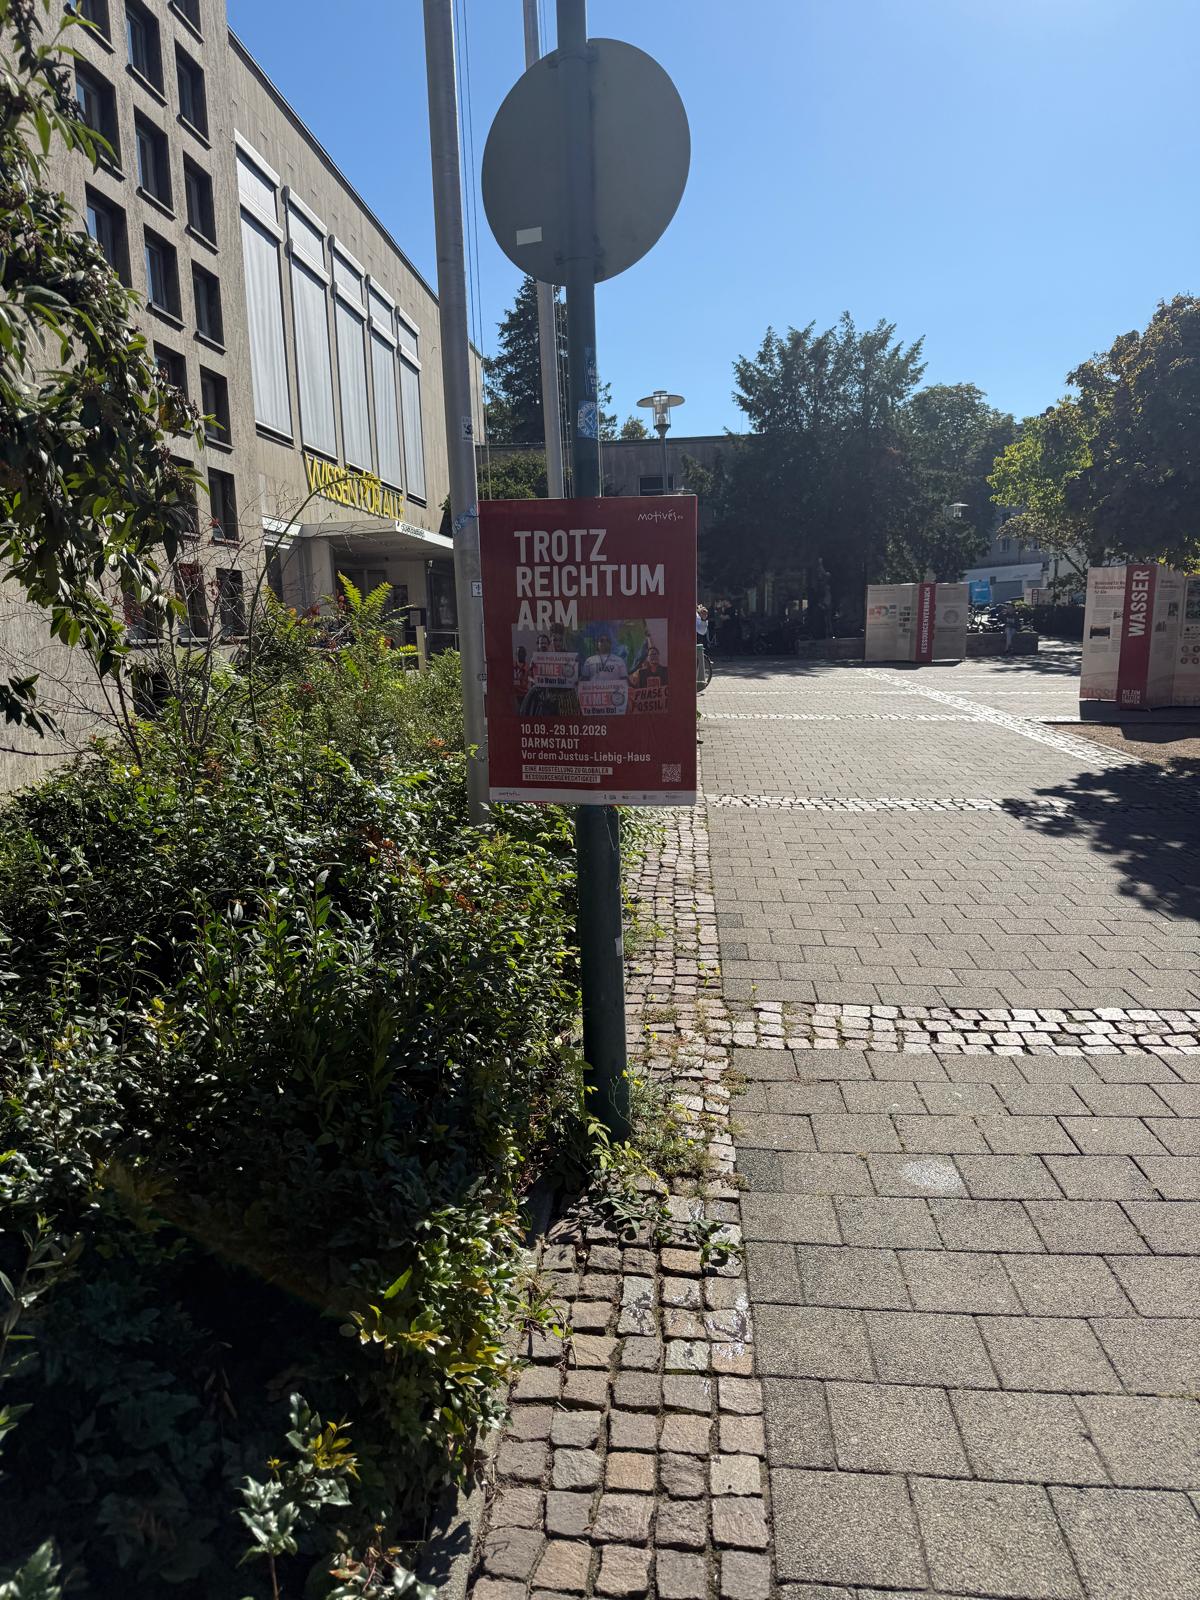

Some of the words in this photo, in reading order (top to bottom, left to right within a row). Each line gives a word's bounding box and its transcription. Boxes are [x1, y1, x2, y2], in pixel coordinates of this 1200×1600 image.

[304, 452, 359, 506] WISSEN
[514, 529, 607, 563] TROTZ
[516, 564, 665, 597] REICHTUM
[1128, 570, 1150, 637] WASSER
[517, 600, 578, 631] ARM
[582, 693, 608, 706] TIME
[635, 688, 660, 701] PHASE
[521, 724, 607, 736] 10.09.-29.10.2026
[521, 737, 580, 749] DARMSTADT
[521, 750, 536, 760] Vor
[538, 751, 557, 760] dem
[558, 751, 651, 764] Justus-Liebig-Haus
